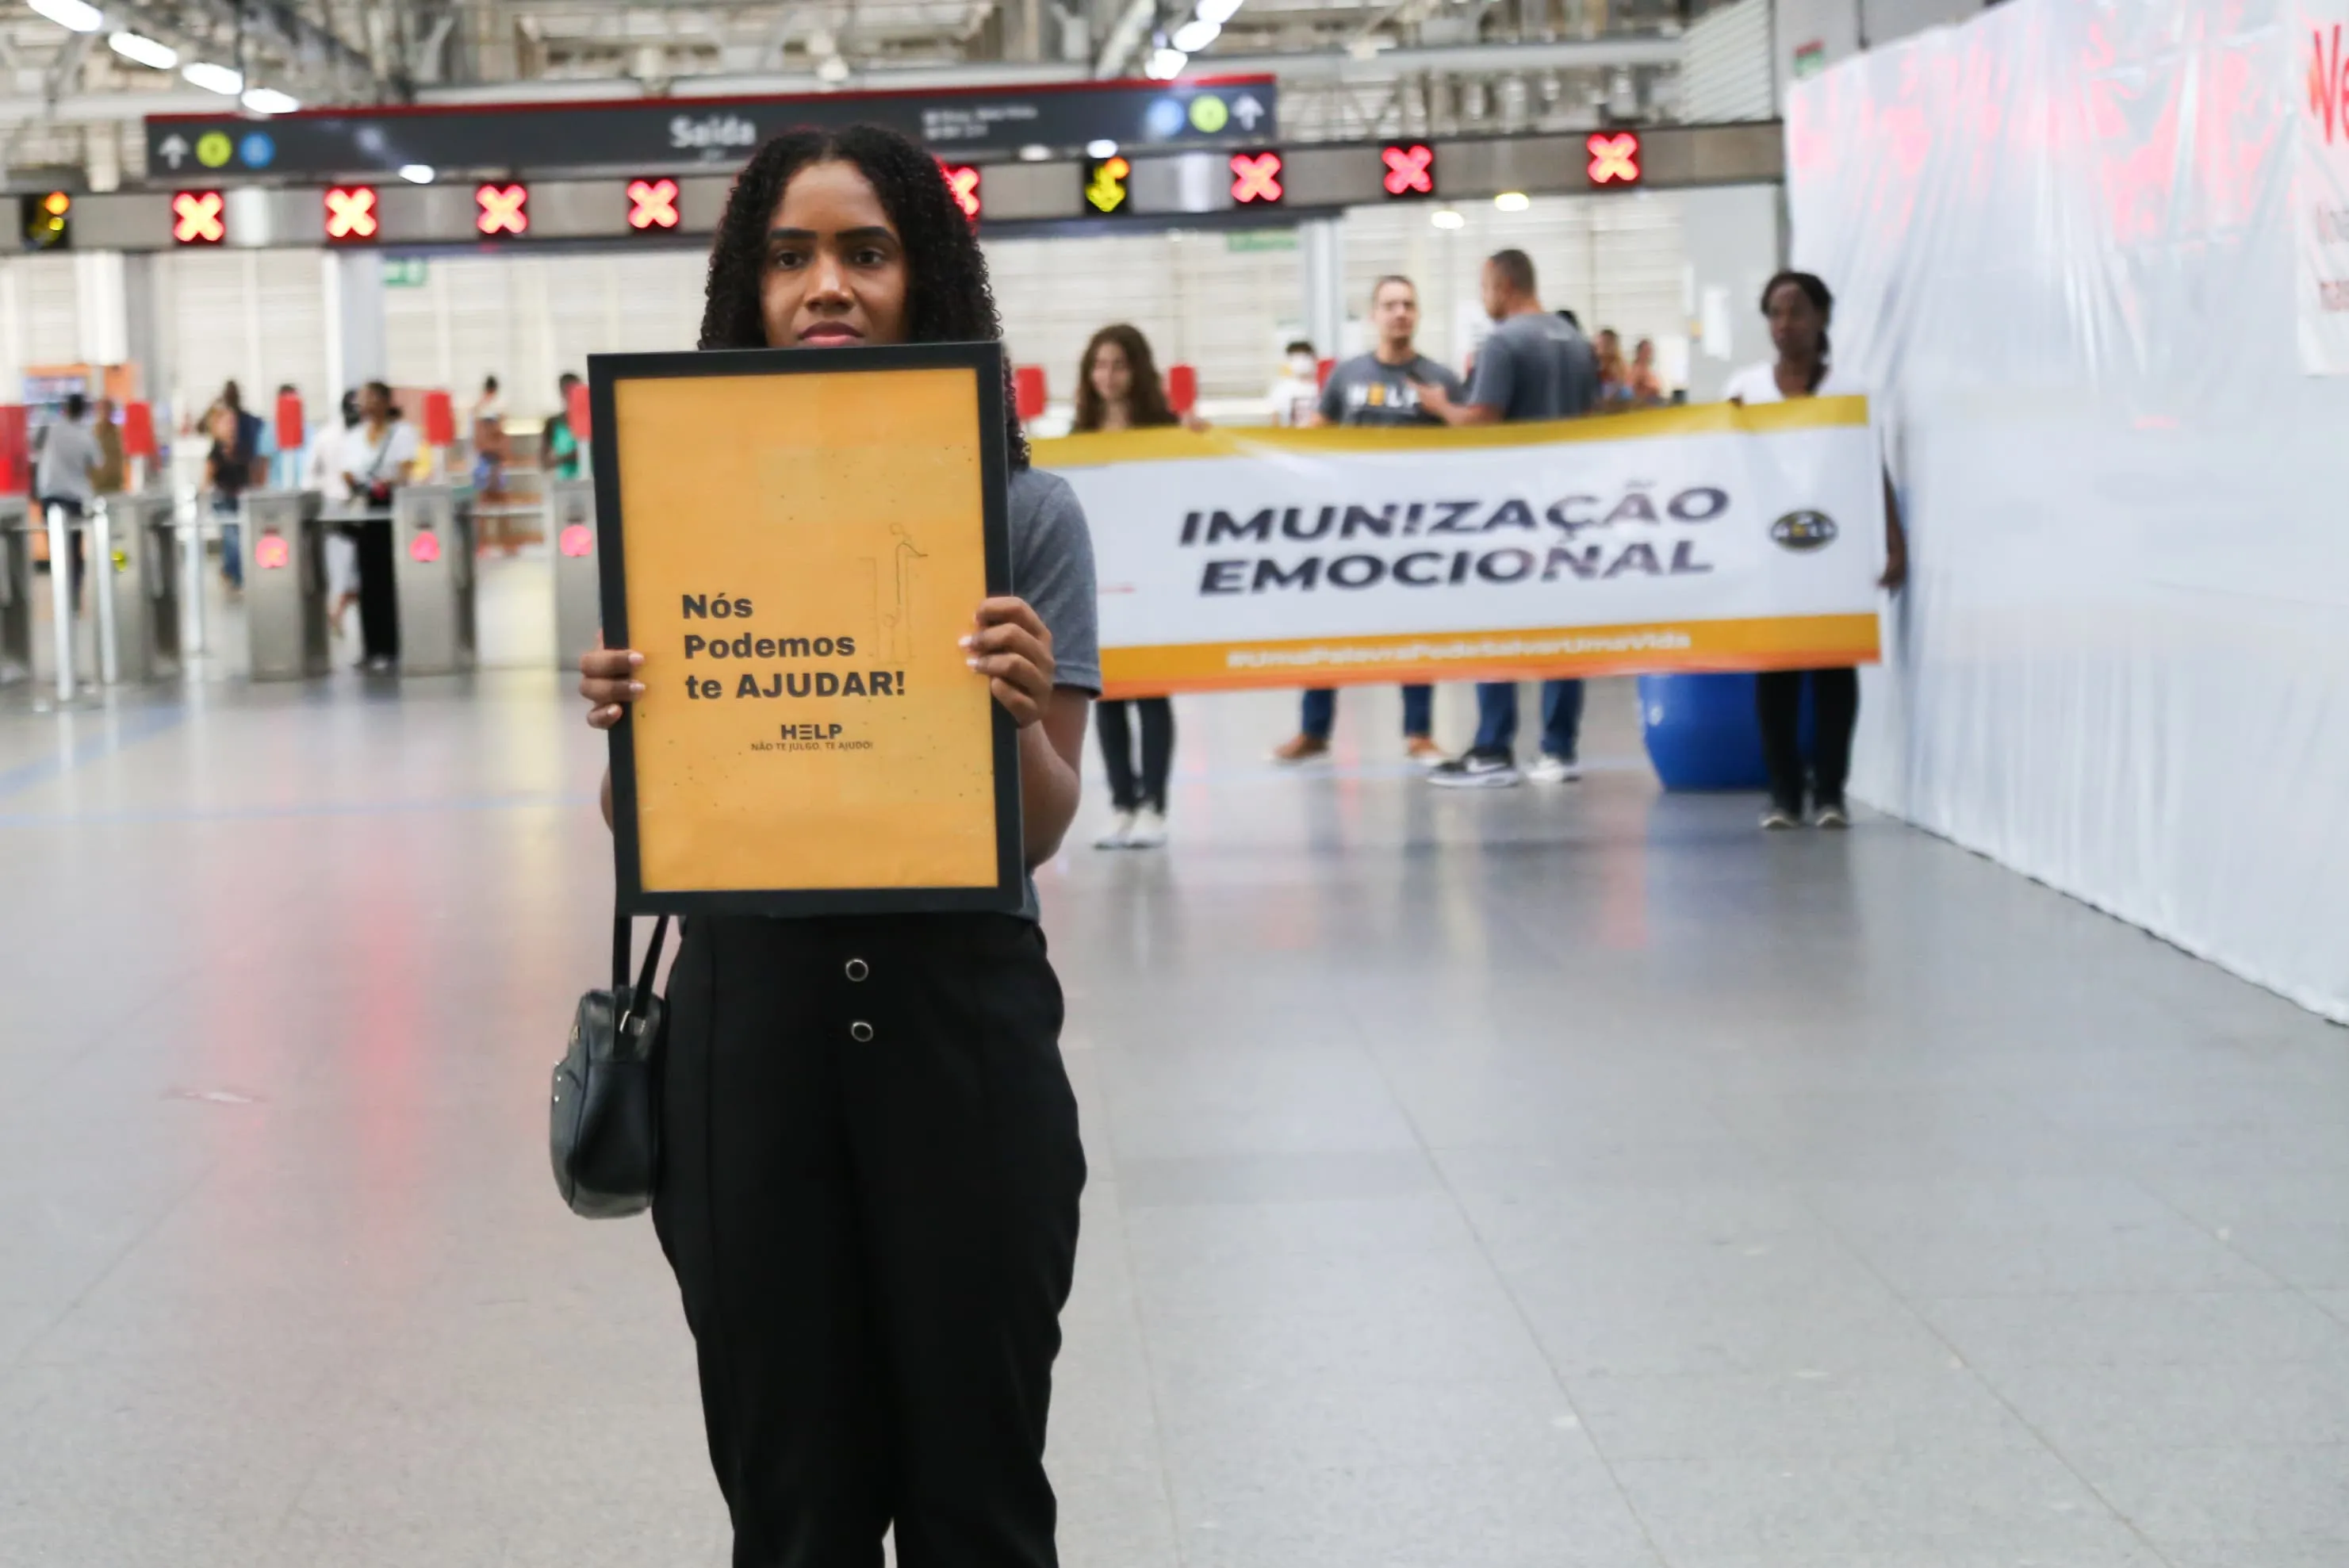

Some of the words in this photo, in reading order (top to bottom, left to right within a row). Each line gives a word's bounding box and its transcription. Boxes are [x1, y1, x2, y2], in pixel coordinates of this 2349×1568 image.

[1179, 479, 1730, 547] IMUNIZAÇÃO
[1197, 539, 1715, 596] EMOCIONAL
[682, 592, 753, 619] Nós
[684, 632, 856, 659] Podemos
[685, 675, 722, 700] te
[735, 671, 905, 699] AJUDAR!
[780, 723, 843, 740] HELP
[751, 740, 773, 751] NÃO
